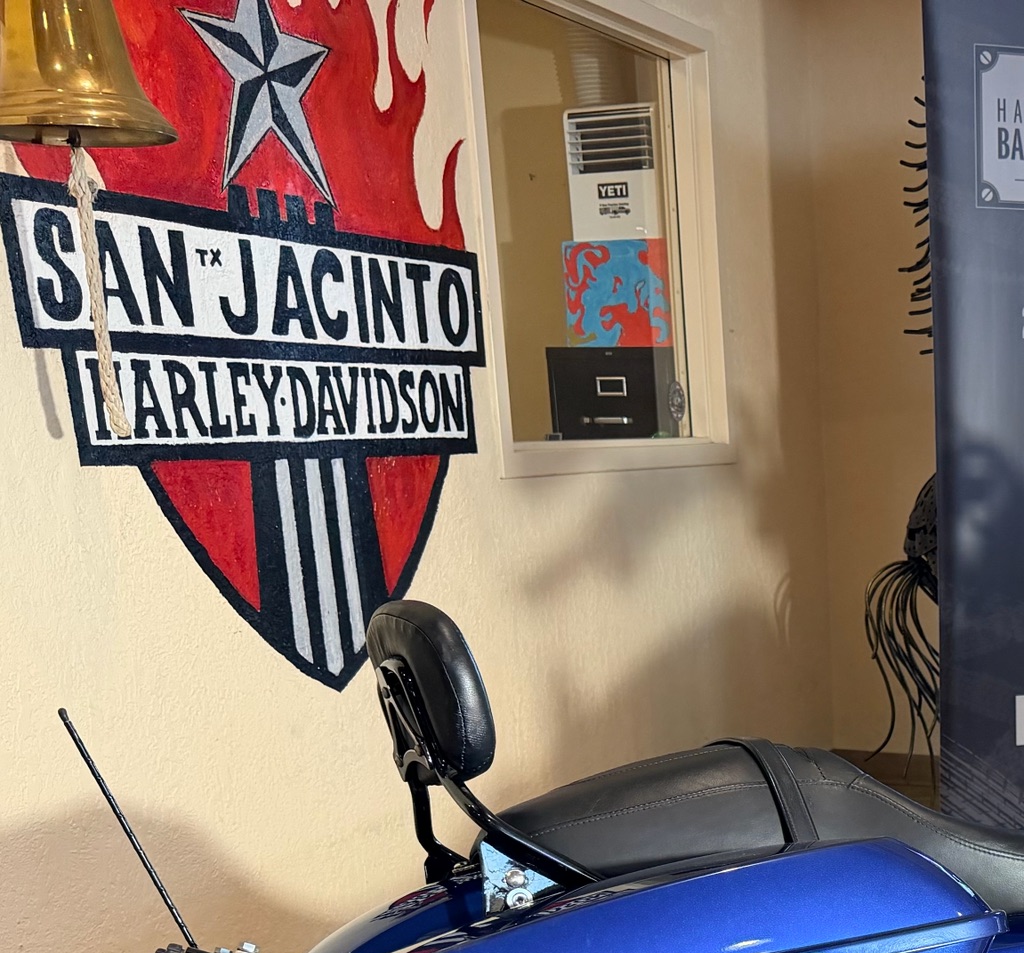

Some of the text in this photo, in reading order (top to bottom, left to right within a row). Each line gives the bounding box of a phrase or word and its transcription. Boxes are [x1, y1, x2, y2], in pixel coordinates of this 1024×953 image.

[598, 184, 626, 197] YETI
[33, 207, 195, 327] SAN
[196, 248, 223, 267] TX
[220, 239, 470, 346] JACINTO
